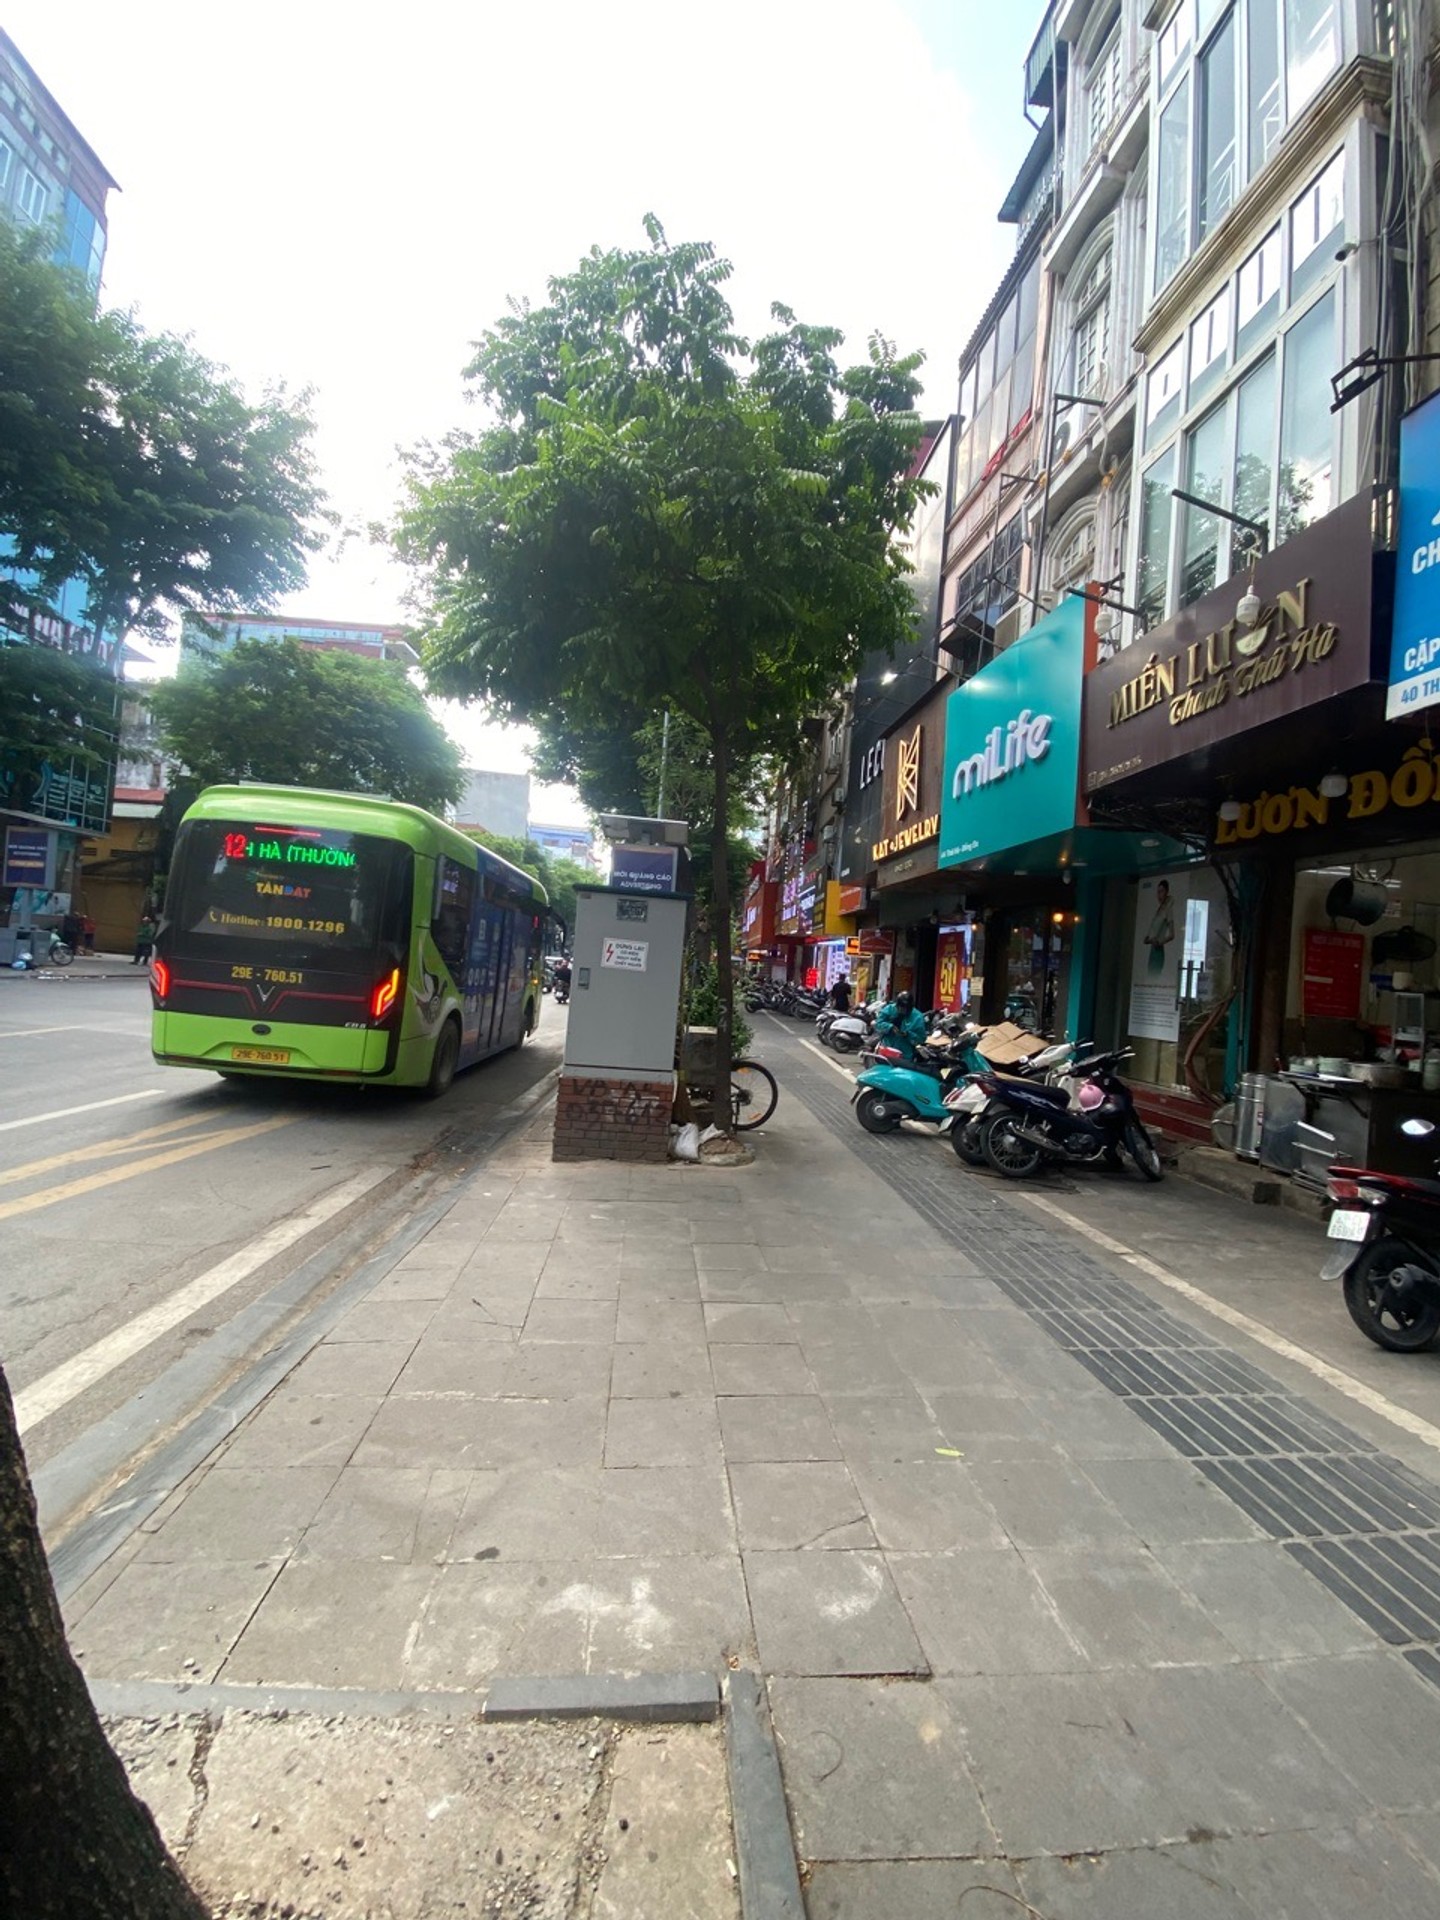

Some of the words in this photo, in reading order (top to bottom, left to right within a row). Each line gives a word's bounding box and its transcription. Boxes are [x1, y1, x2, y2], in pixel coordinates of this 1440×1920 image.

[1169, 673, 1230, 726] Thanh
[1290, 622, 1337, 672] Hà
[1106, 652, 1177, 729] MIẾN
[1401, 685, 1418, 704] 40
[225, 833, 246, 858] 12
[259, 841, 281, 860] HÀ
[266, 916, 345, 934] 1900.1296
[231, 965, 253, 979] 29E
[264, 968, 303, 984] 760.51
